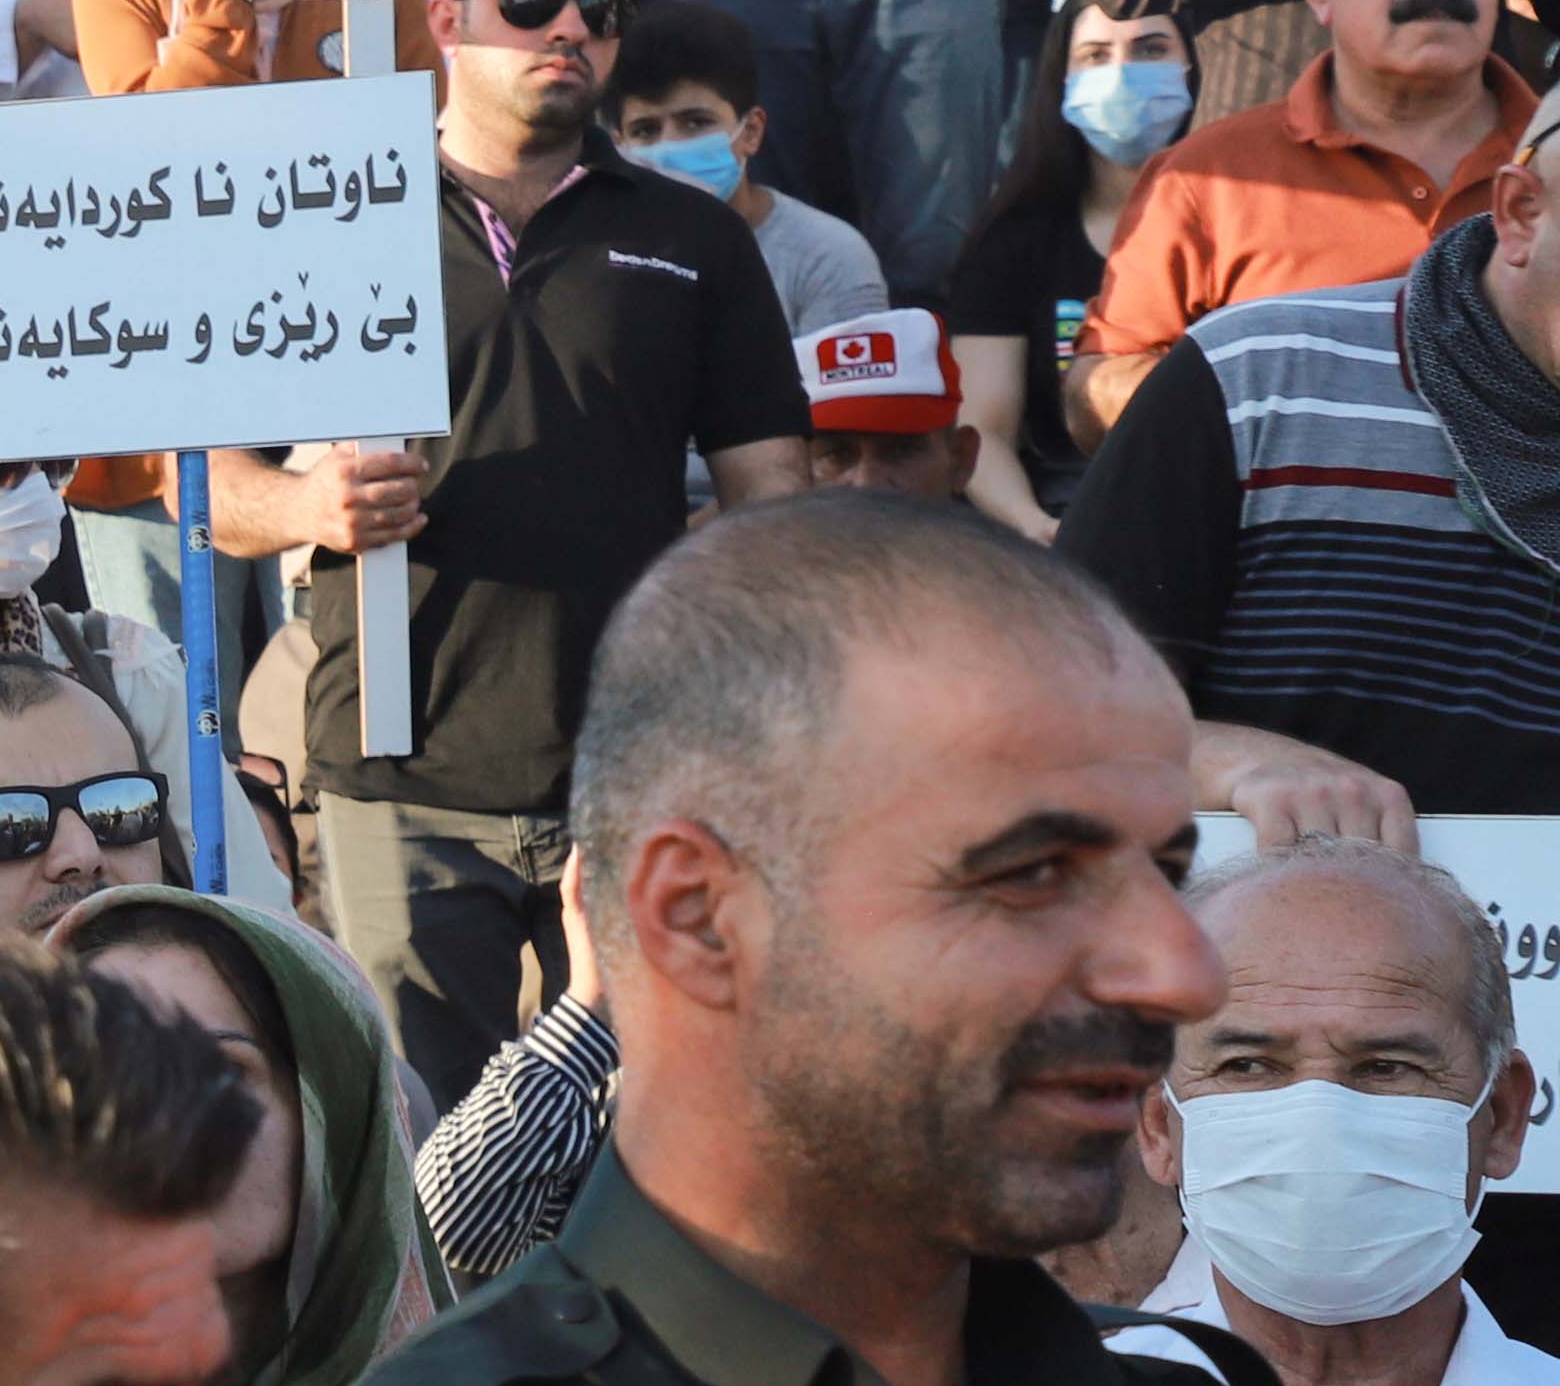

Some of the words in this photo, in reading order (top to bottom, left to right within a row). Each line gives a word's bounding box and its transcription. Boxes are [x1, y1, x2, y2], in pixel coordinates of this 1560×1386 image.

[194, 161, 236, 218] نا
[257, 148, 408, 230] ناوتان
[185, 312, 213, 365] و
[360, 283, 418, 356] بێ
